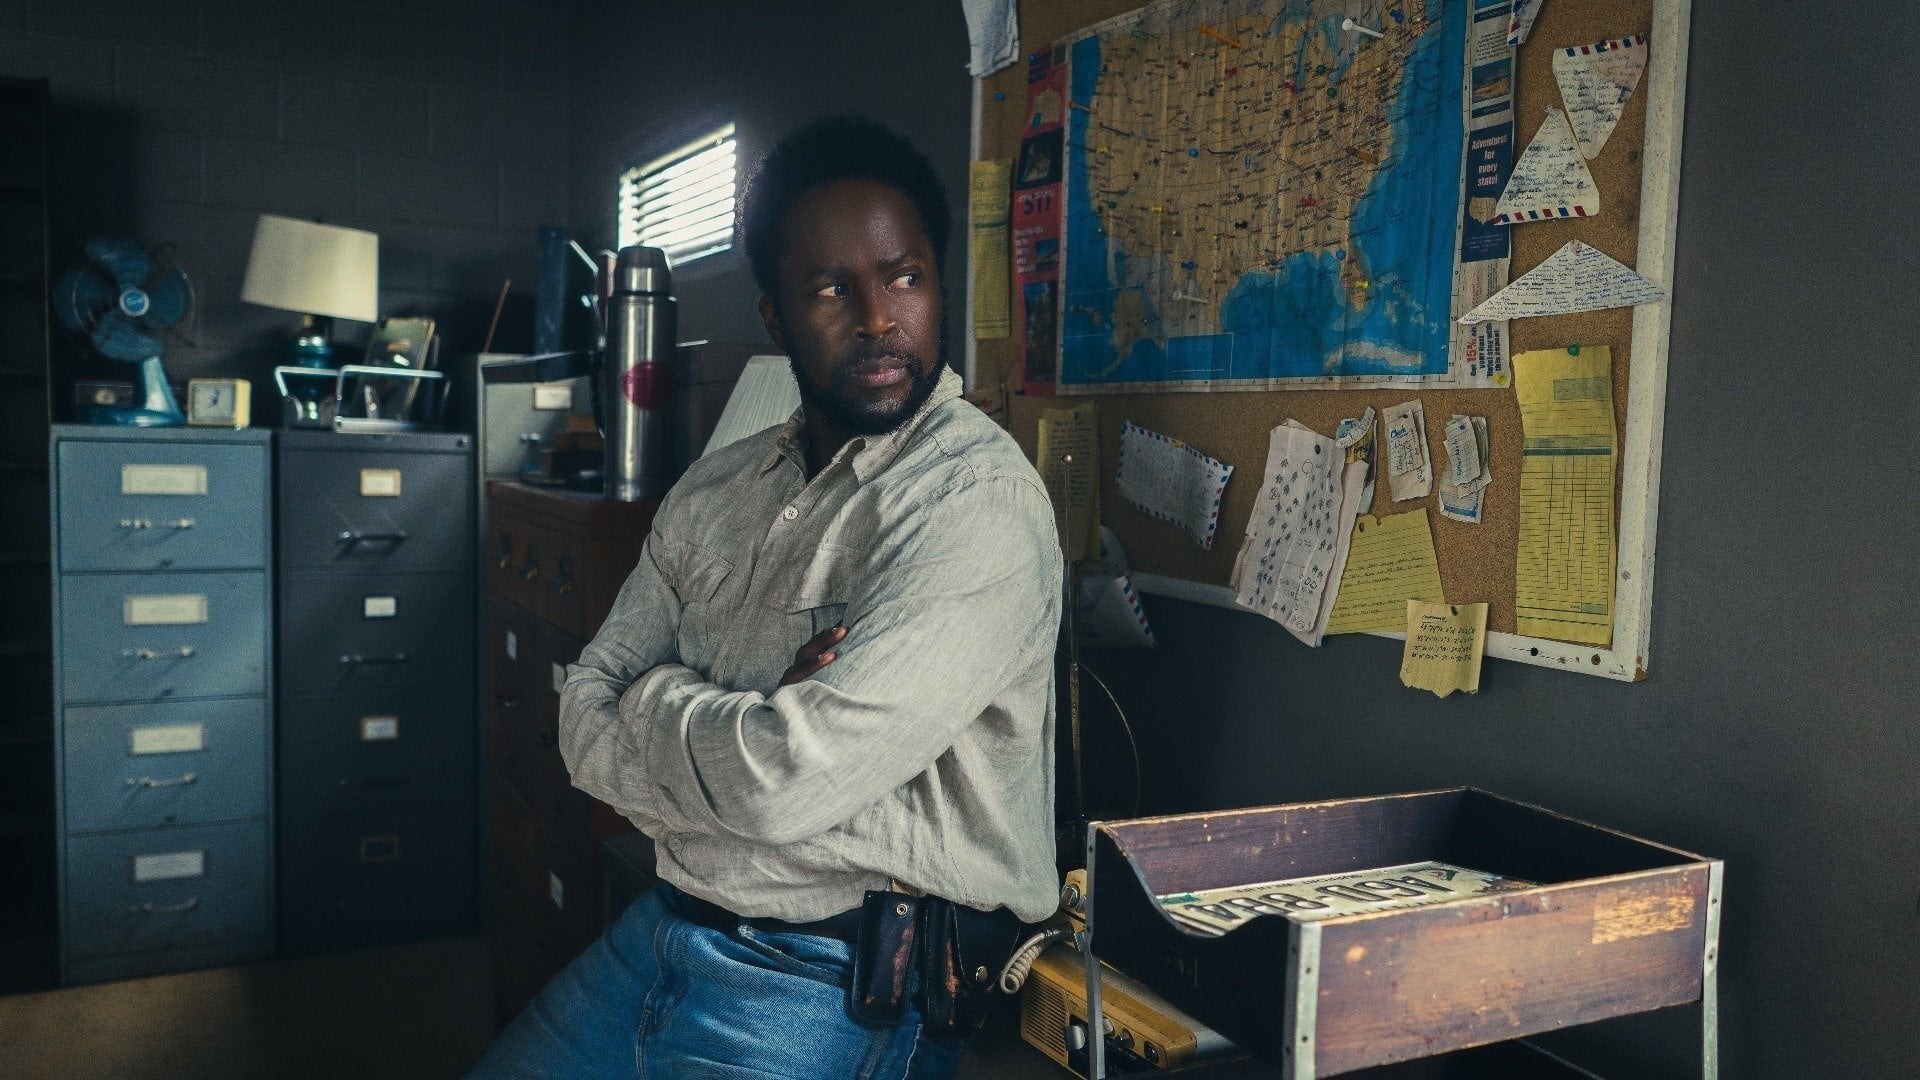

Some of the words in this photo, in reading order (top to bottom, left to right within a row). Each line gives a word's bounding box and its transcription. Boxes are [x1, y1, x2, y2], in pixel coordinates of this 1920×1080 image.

[1471, 134, 1508, 150] Adventures
[1484, 150, 1495, 160] for
[1478, 162, 1498, 174] every
[1477, 175, 1499, 187] state!
[1485, 322, 1493, 339] with
[1466, 338, 1477, 363] 15%
[1486, 340, 1494, 356] stay
[1494, 356, 1502, 372] this
